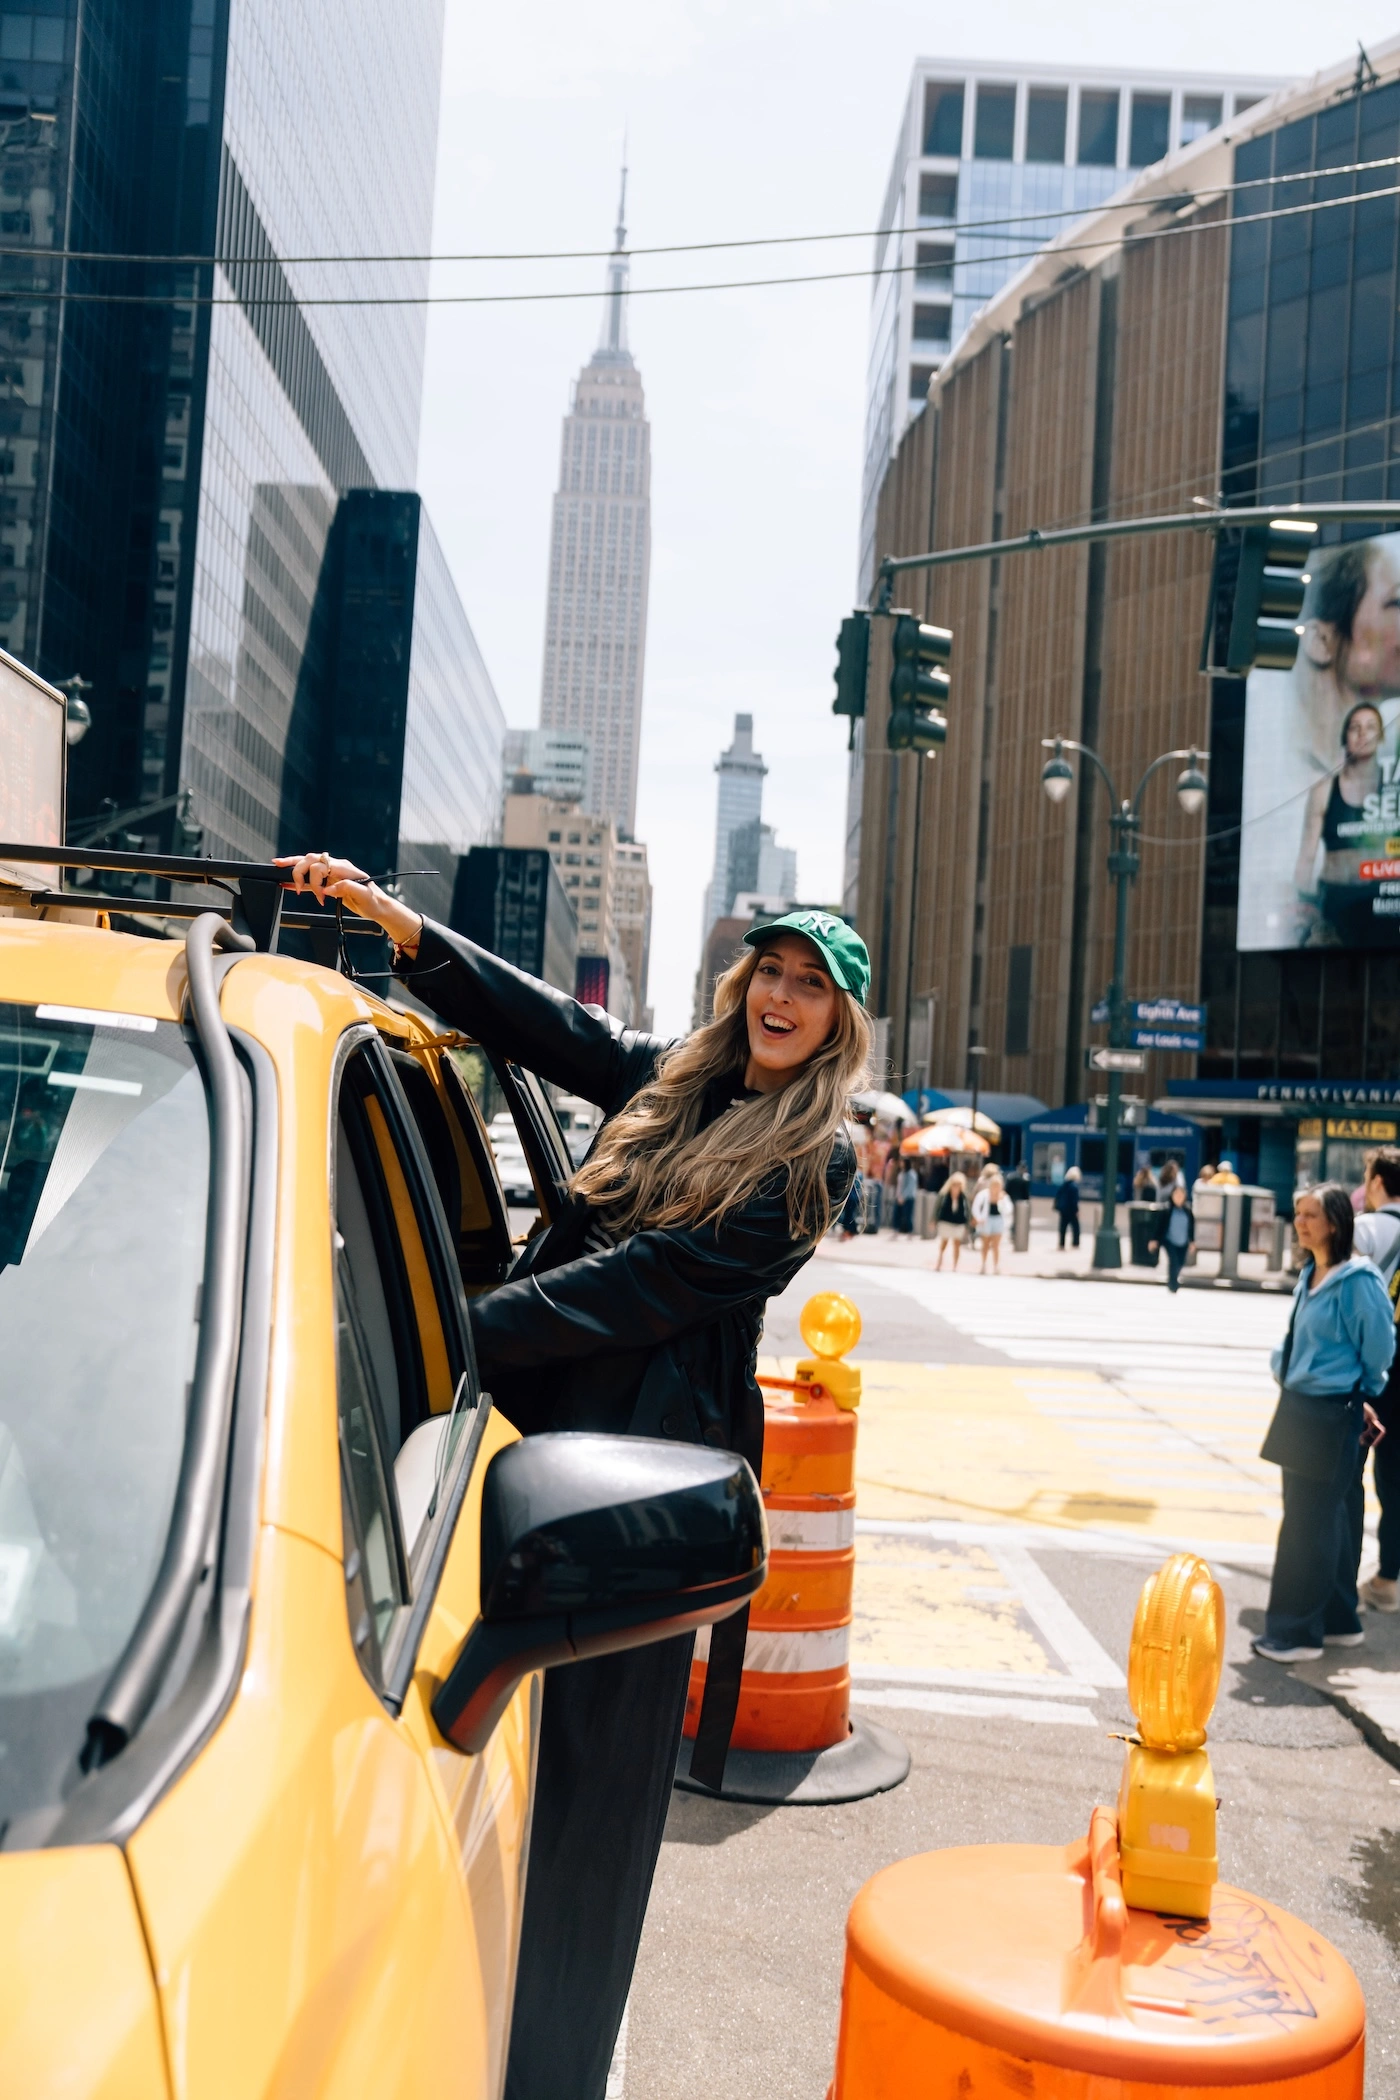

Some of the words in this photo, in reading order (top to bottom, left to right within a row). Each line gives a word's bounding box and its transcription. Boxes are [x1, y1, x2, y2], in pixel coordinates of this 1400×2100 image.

[1362, 791, 1400, 821] SE
[1372, 861, 1400, 878] LIVE
[1137, 1002, 1175, 1022] Eighth
[1176, 1006, 1201, 1021] Ave
[1136, 1031, 1154, 1046] Joe
[1155, 1033, 1182, 1049] Louis
[1257, 1085, 1400, 1103] PENNSYLVANIA
[1330, 1119, 1372, 1138] TAXI
